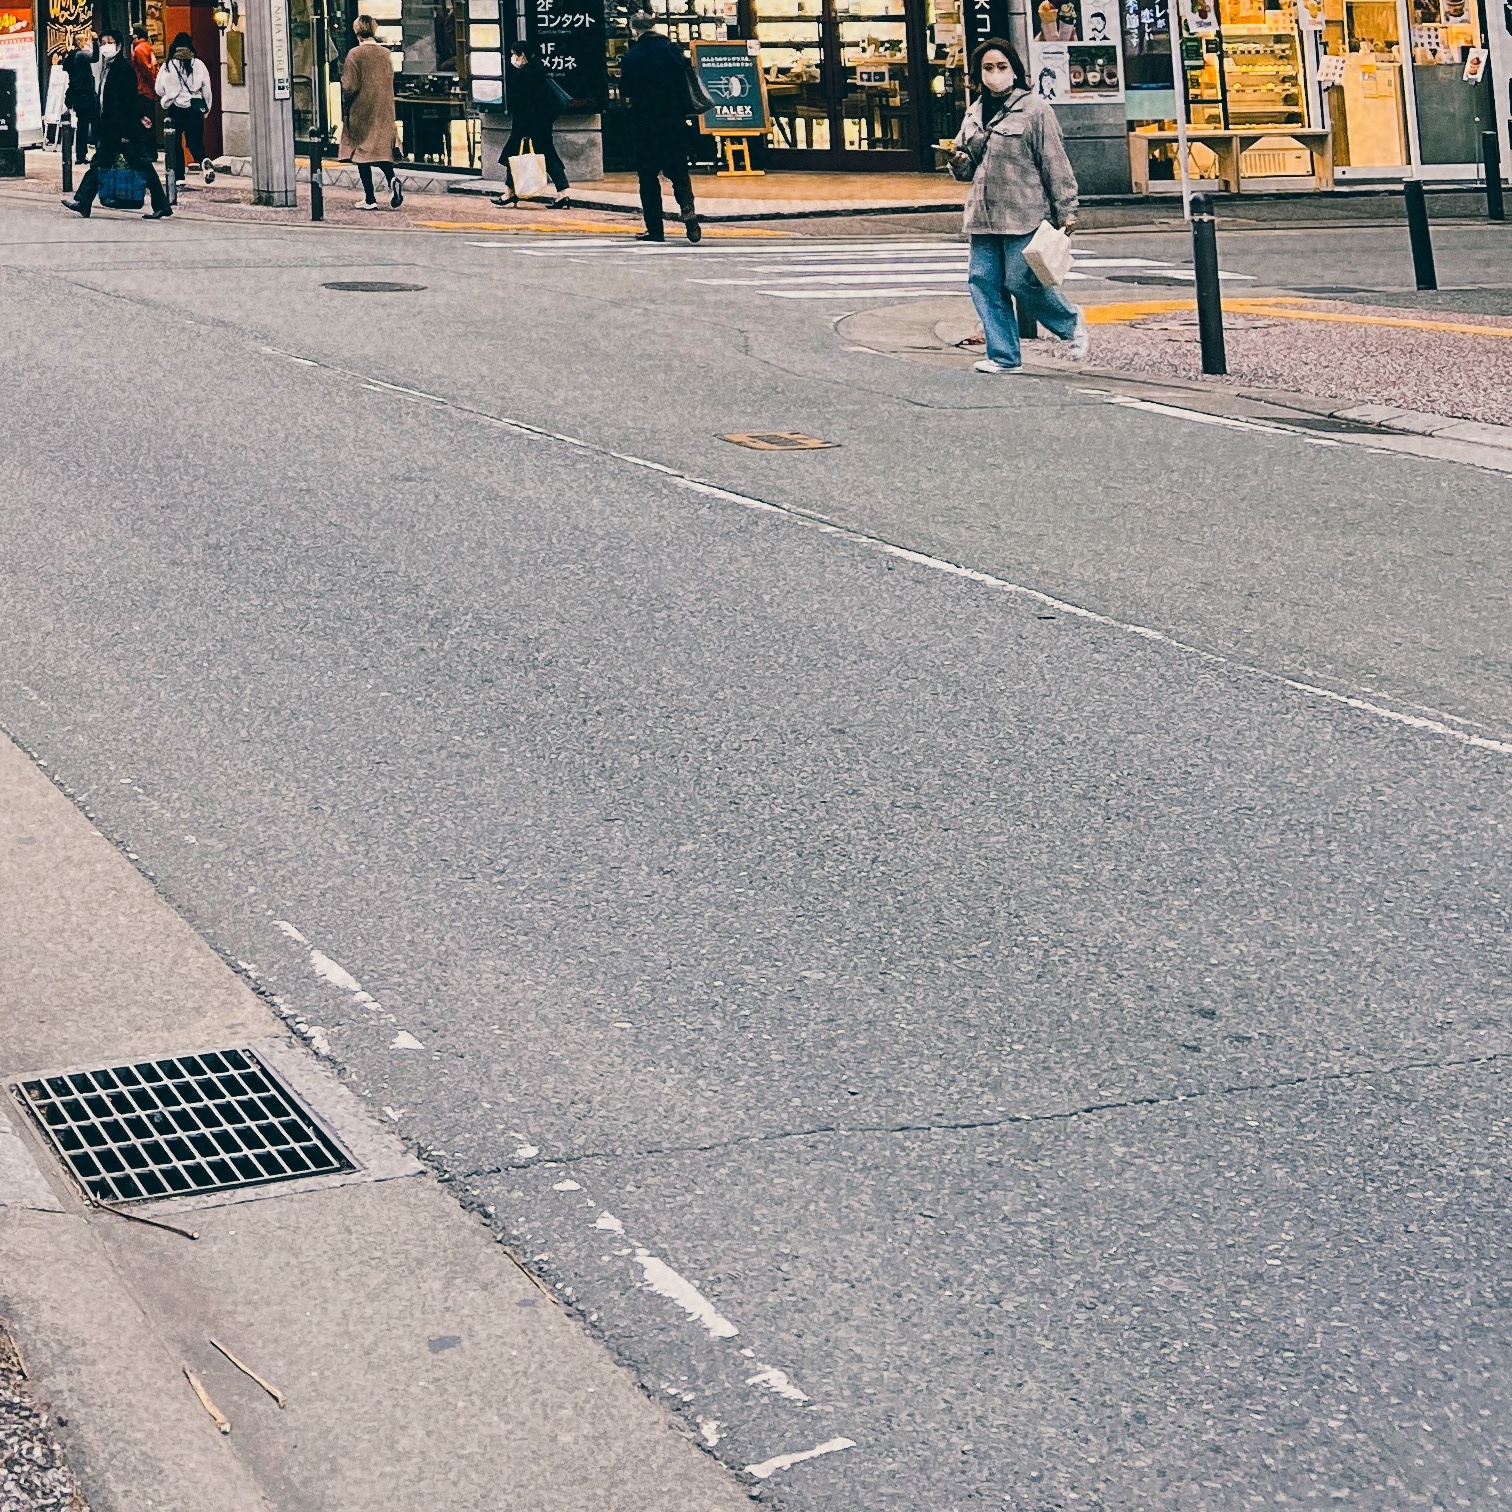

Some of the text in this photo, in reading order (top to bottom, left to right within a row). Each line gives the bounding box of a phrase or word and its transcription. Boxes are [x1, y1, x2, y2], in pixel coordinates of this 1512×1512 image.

[536, 0, 553, 11] 2F
[537, 13, 596, 27] コンタクト
[539, 43, 556, 54] 1F
[540, 56, 577, 70] メガネ
[715, 105, 752, 115] TALEX
